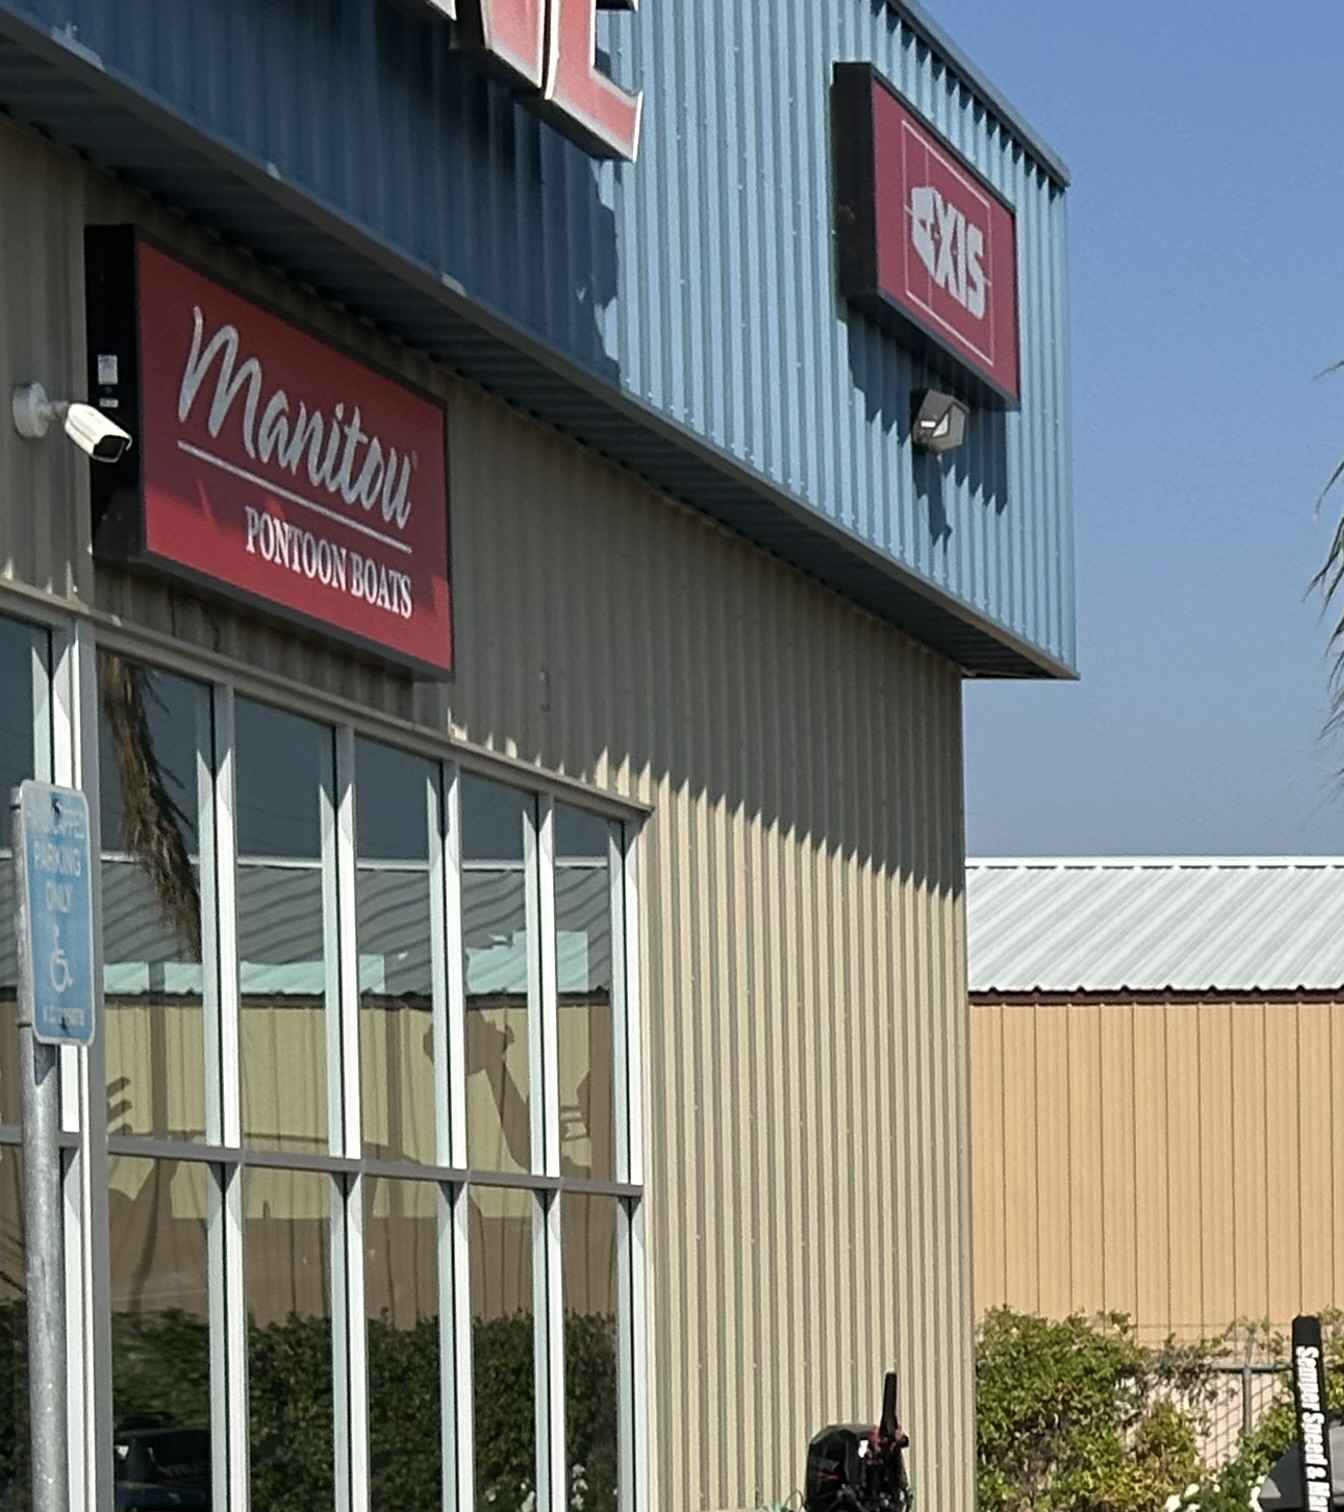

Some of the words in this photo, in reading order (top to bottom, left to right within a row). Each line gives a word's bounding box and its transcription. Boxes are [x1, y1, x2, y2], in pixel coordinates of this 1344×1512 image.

[178, 305, 413, 530] Manitou
[245, 505, 347, 591] PONTOON
[351, 552, 413, 620] BOATS
